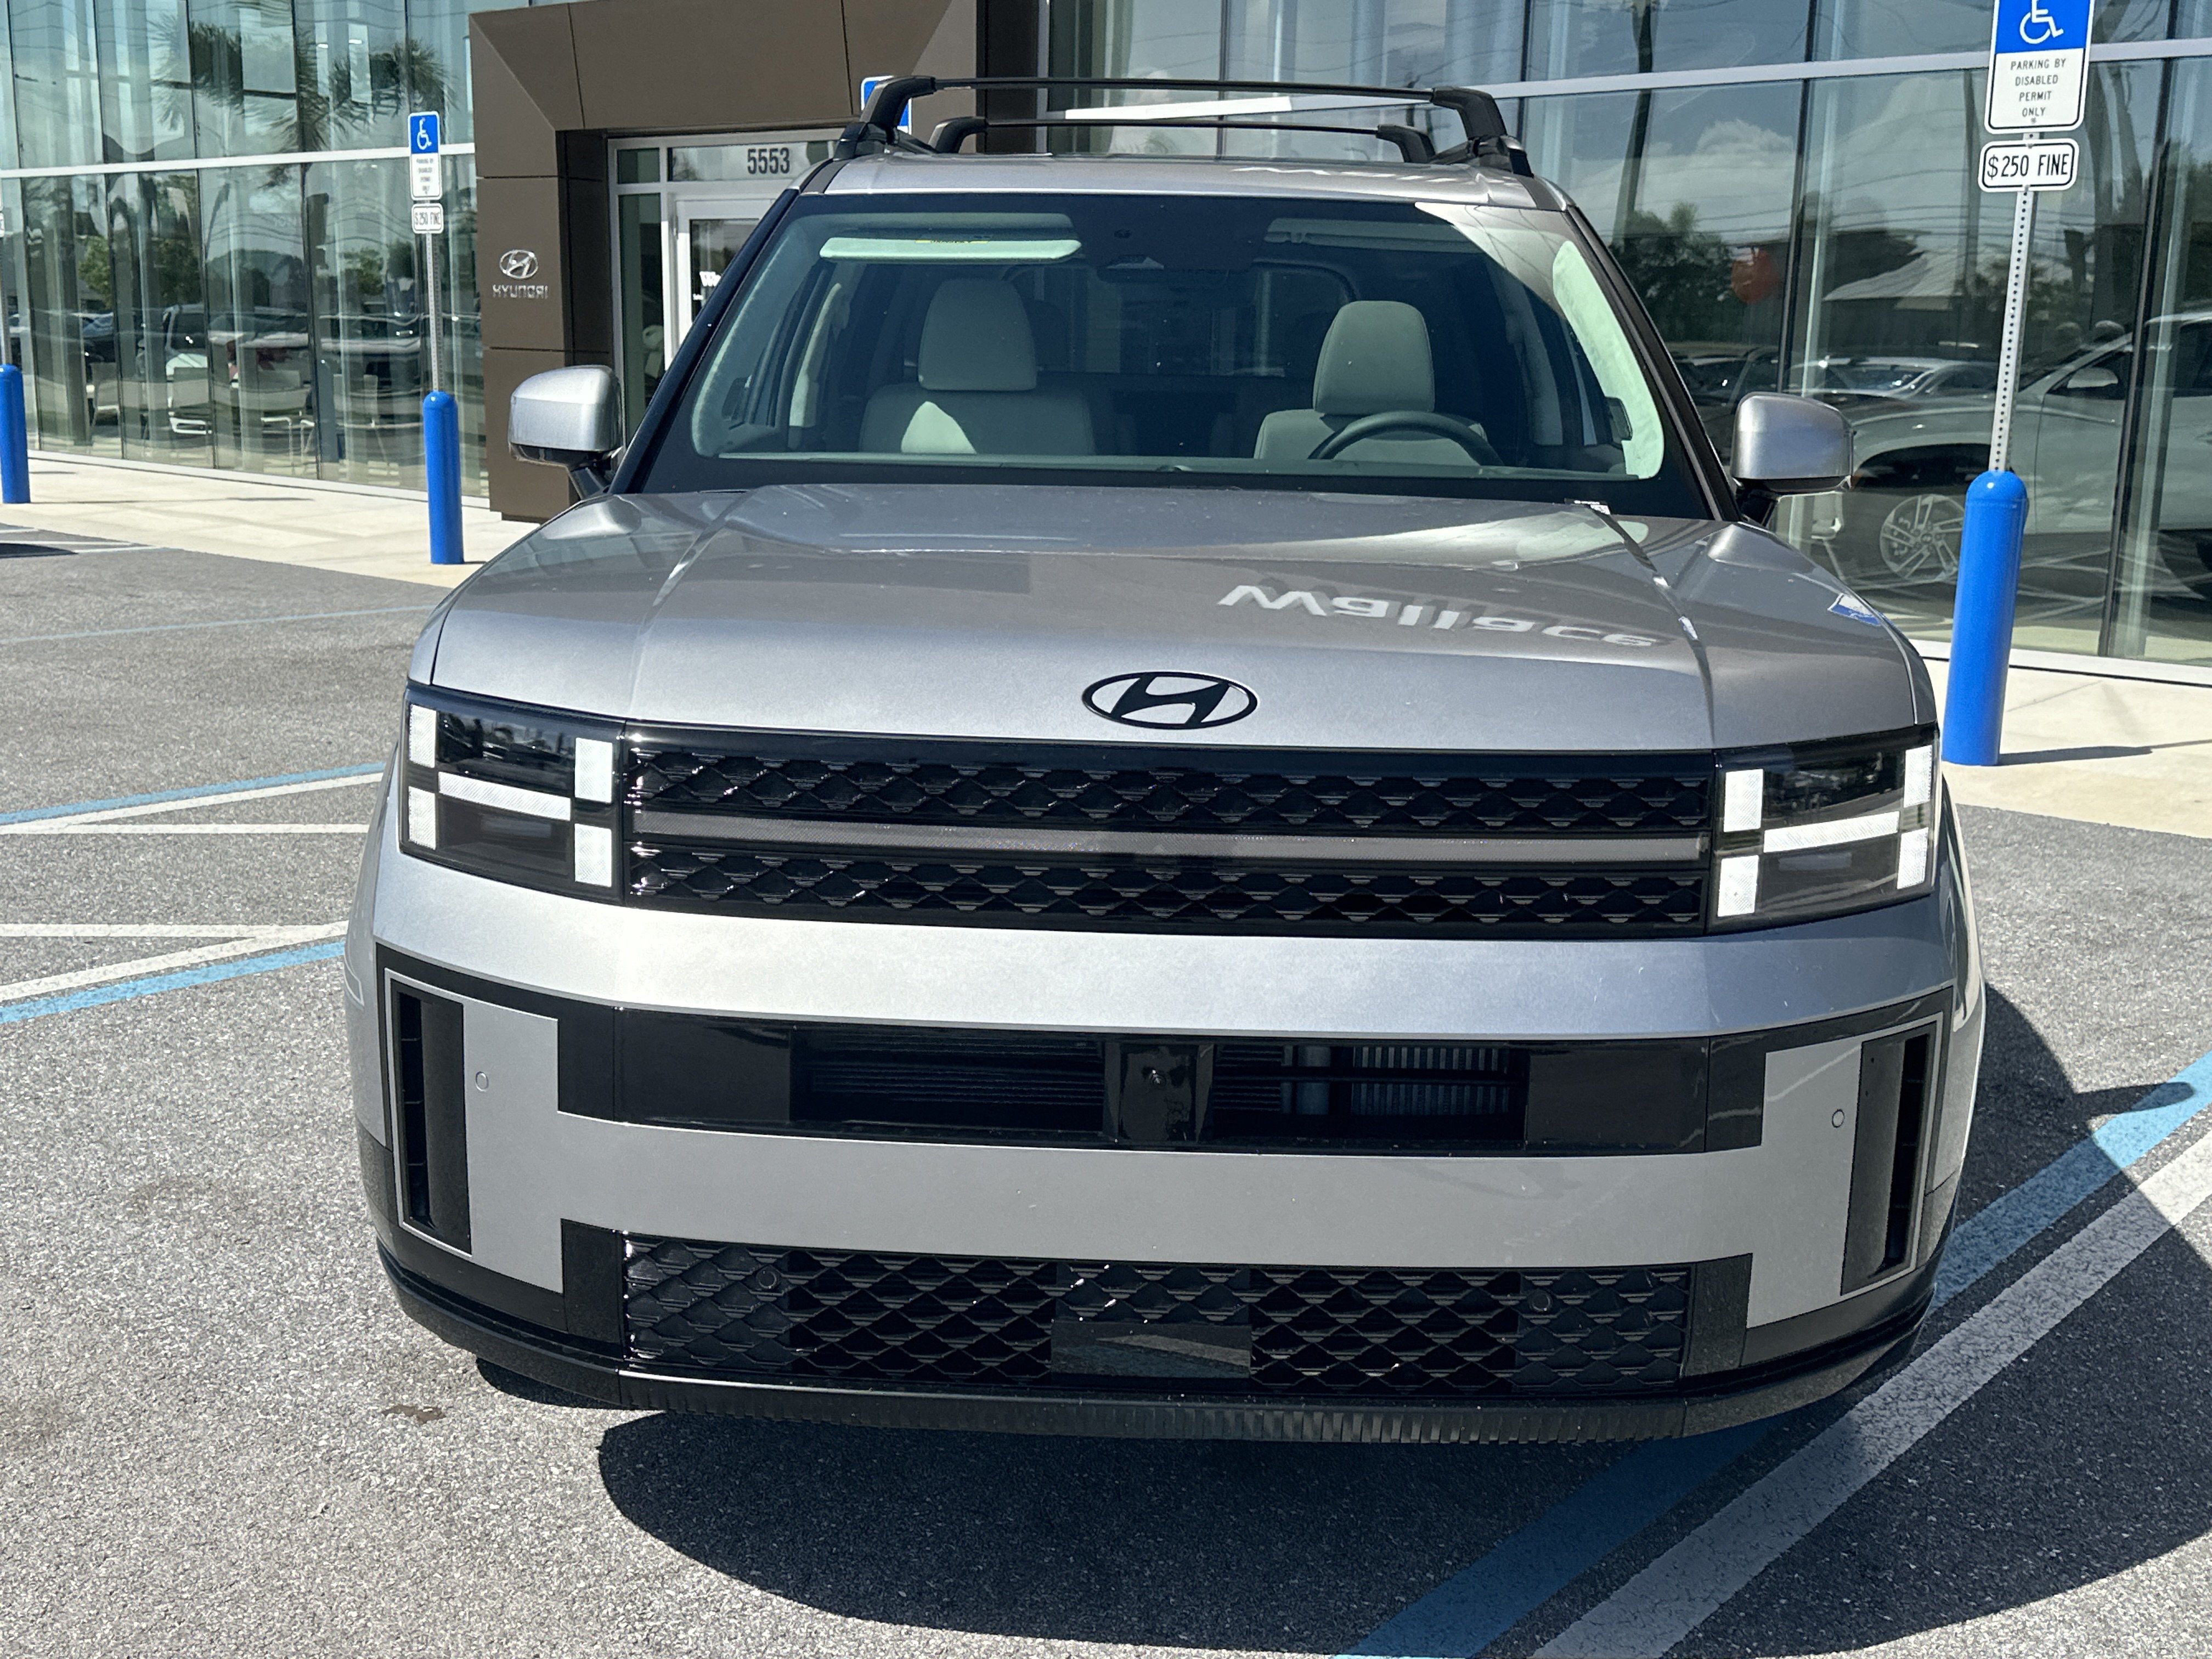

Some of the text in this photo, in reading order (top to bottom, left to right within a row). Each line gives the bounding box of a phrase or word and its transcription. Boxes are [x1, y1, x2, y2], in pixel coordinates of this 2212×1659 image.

[2010, 58, 2067, 70] PARKING BY
[2015, 74, 2058, 86] DISABLED
[2019, 90, 2052, 101] PERMIT
[2022, 107, 2046, 117] ONLY
[747, 147, 790, 174] 5553
[1987, 153, 2069, 180] $250 FINE
[492, 284, 549, 299] HYUNDAI
